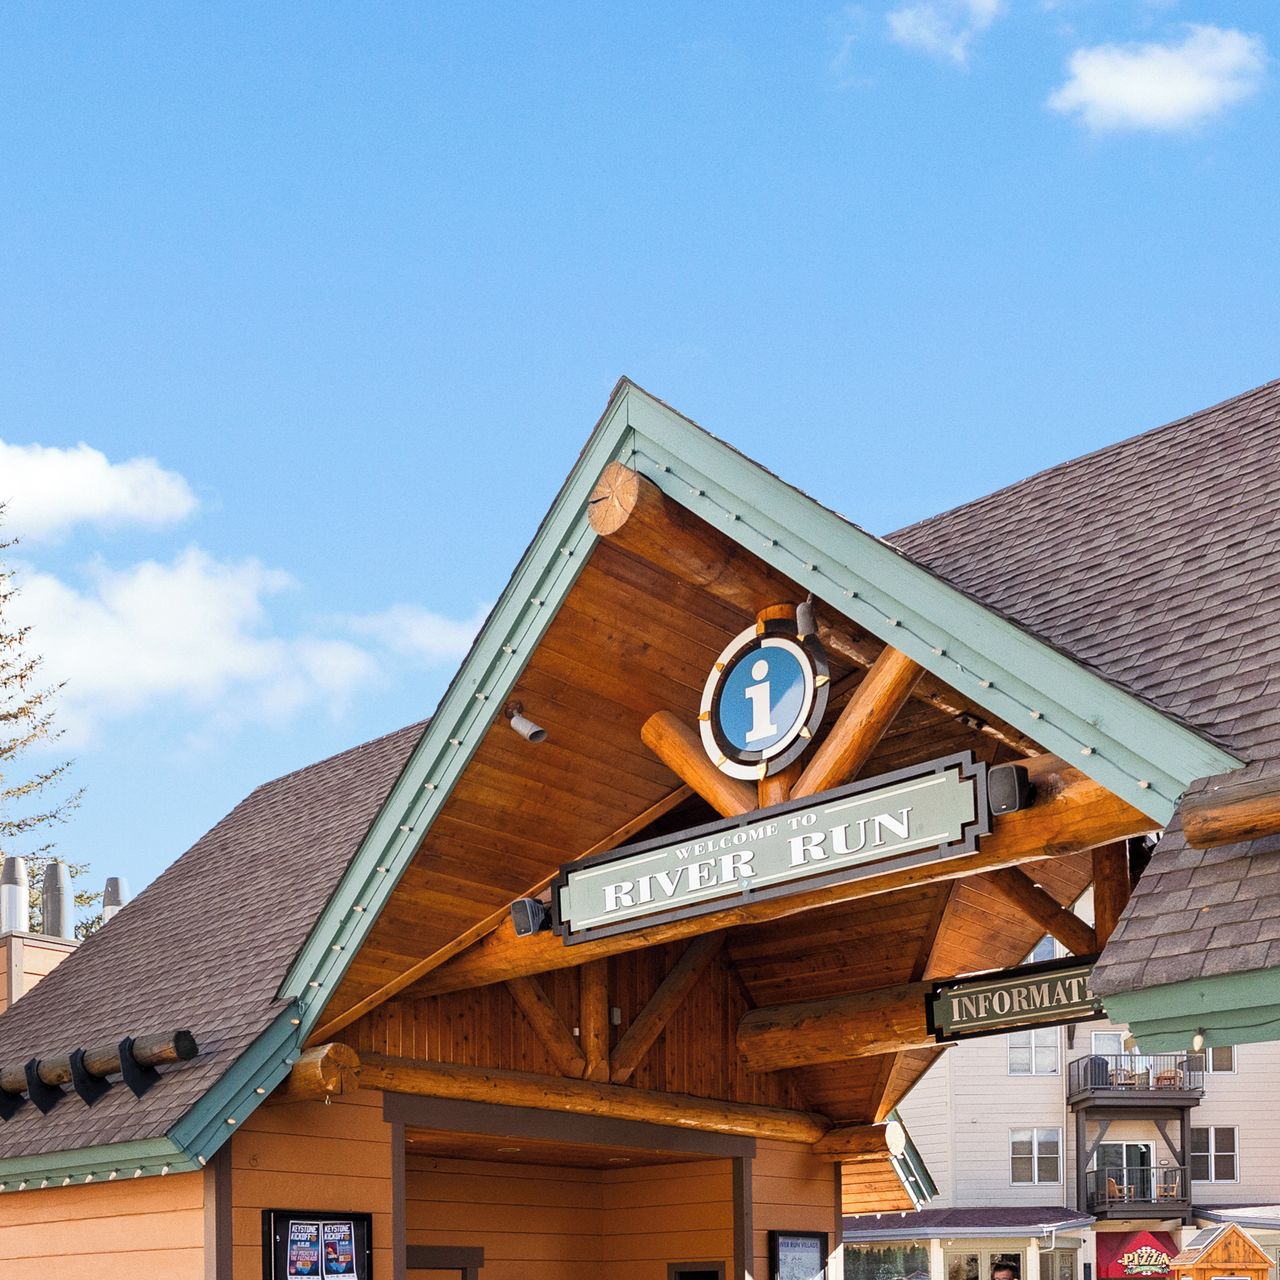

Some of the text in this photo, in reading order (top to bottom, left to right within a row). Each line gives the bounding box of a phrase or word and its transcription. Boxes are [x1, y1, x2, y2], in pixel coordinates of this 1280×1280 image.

[745, 659, 778, 743] i
[674, 812, 818, 861] WELCOME TO
[602, 807, 914, 914] RIVER RUN
[951, 976, 1097, 1022] INFORMATI
[291, 1224, 318, 1233] KEYSTONE
[324, 1224, 350, 1233] KEYSTONE
[290, 1233, 311, 1241] KICKOFF
[790, 1241, 800, 1249] RUN
[801, 1241, 819, 1249] VILLAGE
[1123, 1252, 1170, 1266] PIZZA
